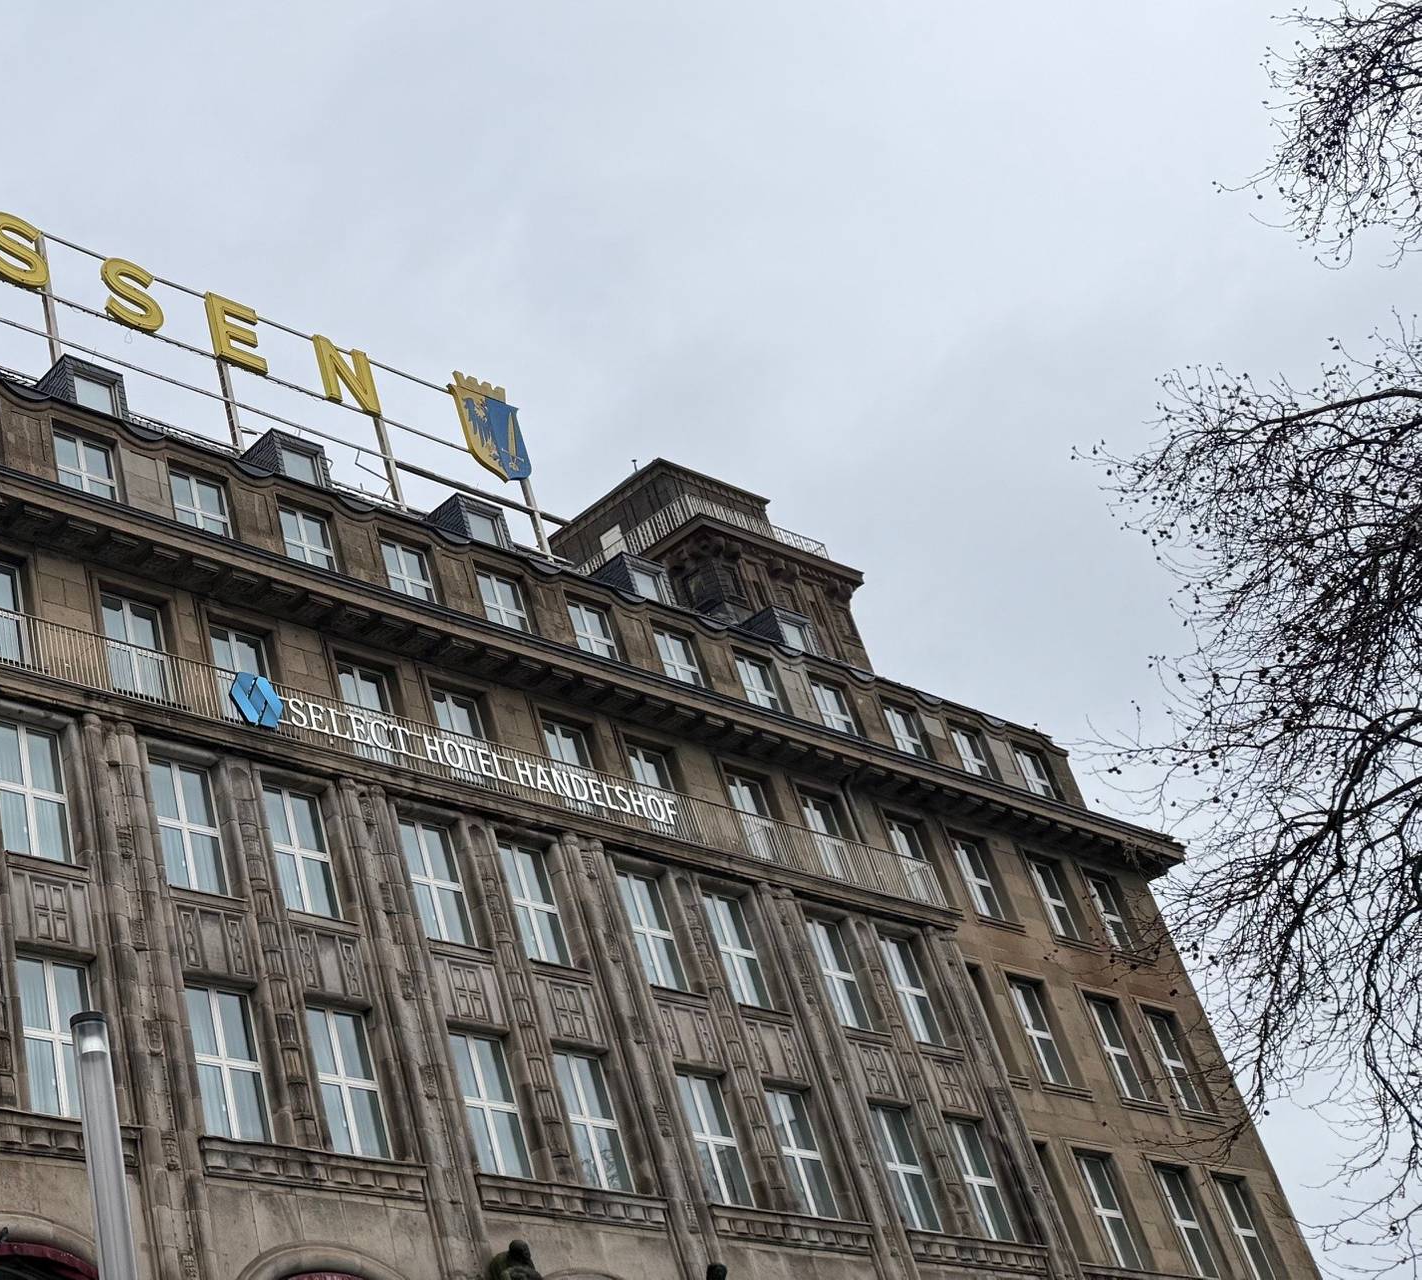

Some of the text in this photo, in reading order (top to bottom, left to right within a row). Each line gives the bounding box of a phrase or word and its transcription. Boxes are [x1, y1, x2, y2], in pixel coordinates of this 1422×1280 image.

[288, 698, 677, 825] SELECT HOTEL HANDELSHOF
